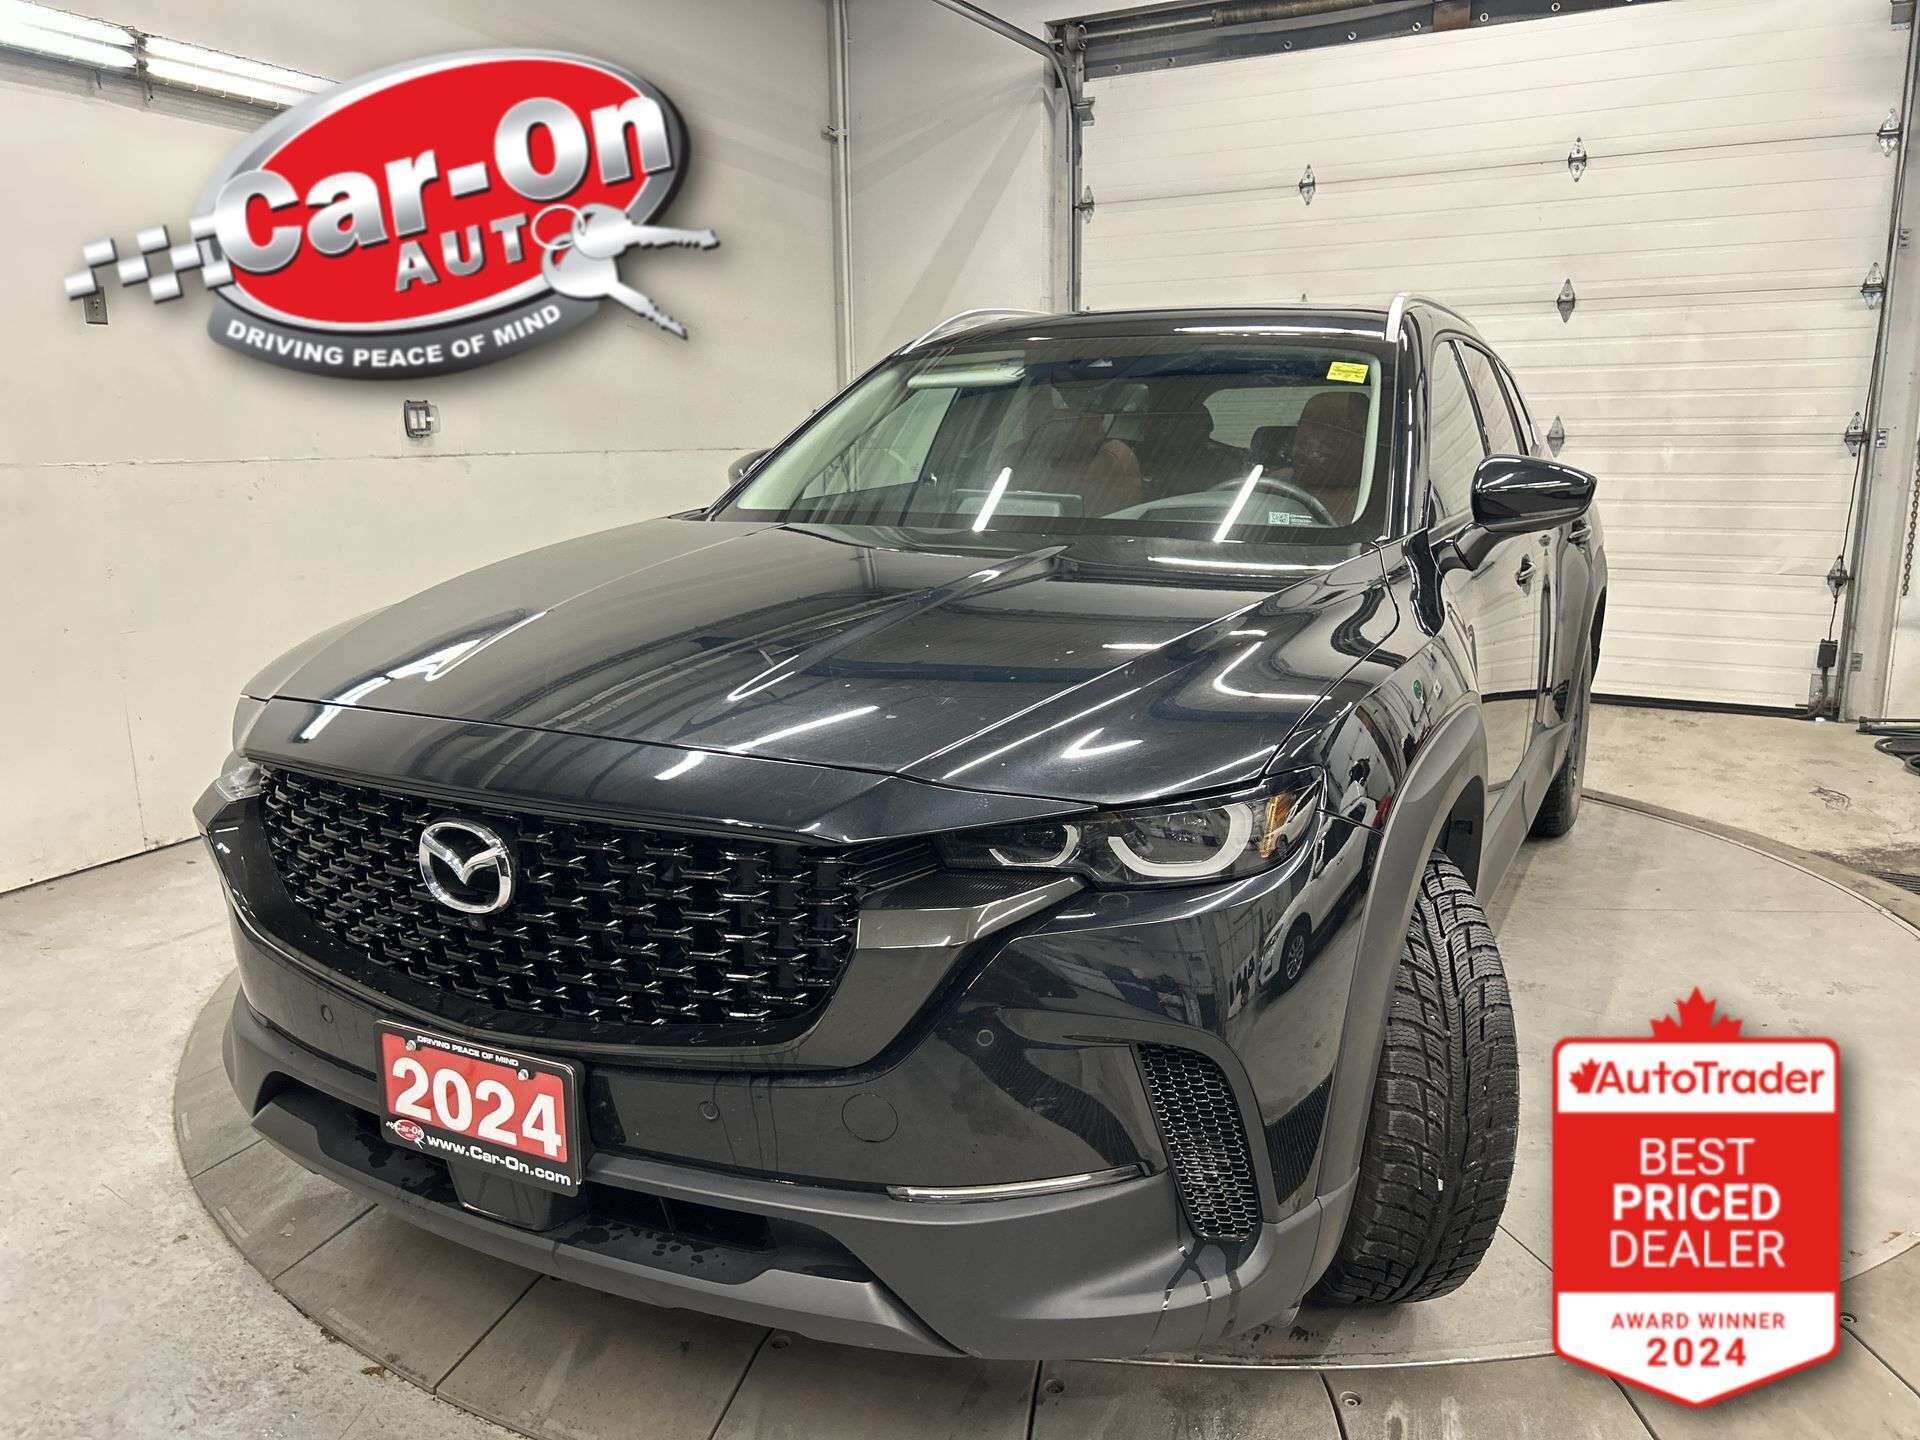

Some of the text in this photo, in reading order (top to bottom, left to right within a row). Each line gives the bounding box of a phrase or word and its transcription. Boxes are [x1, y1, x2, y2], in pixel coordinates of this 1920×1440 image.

[416, 1035, 519, 1067] DRIVING PEACE OF MIND
[392, 1056, 562, 1158] 2024
[426, 1134, 572, 1186] www.Car-On.com
